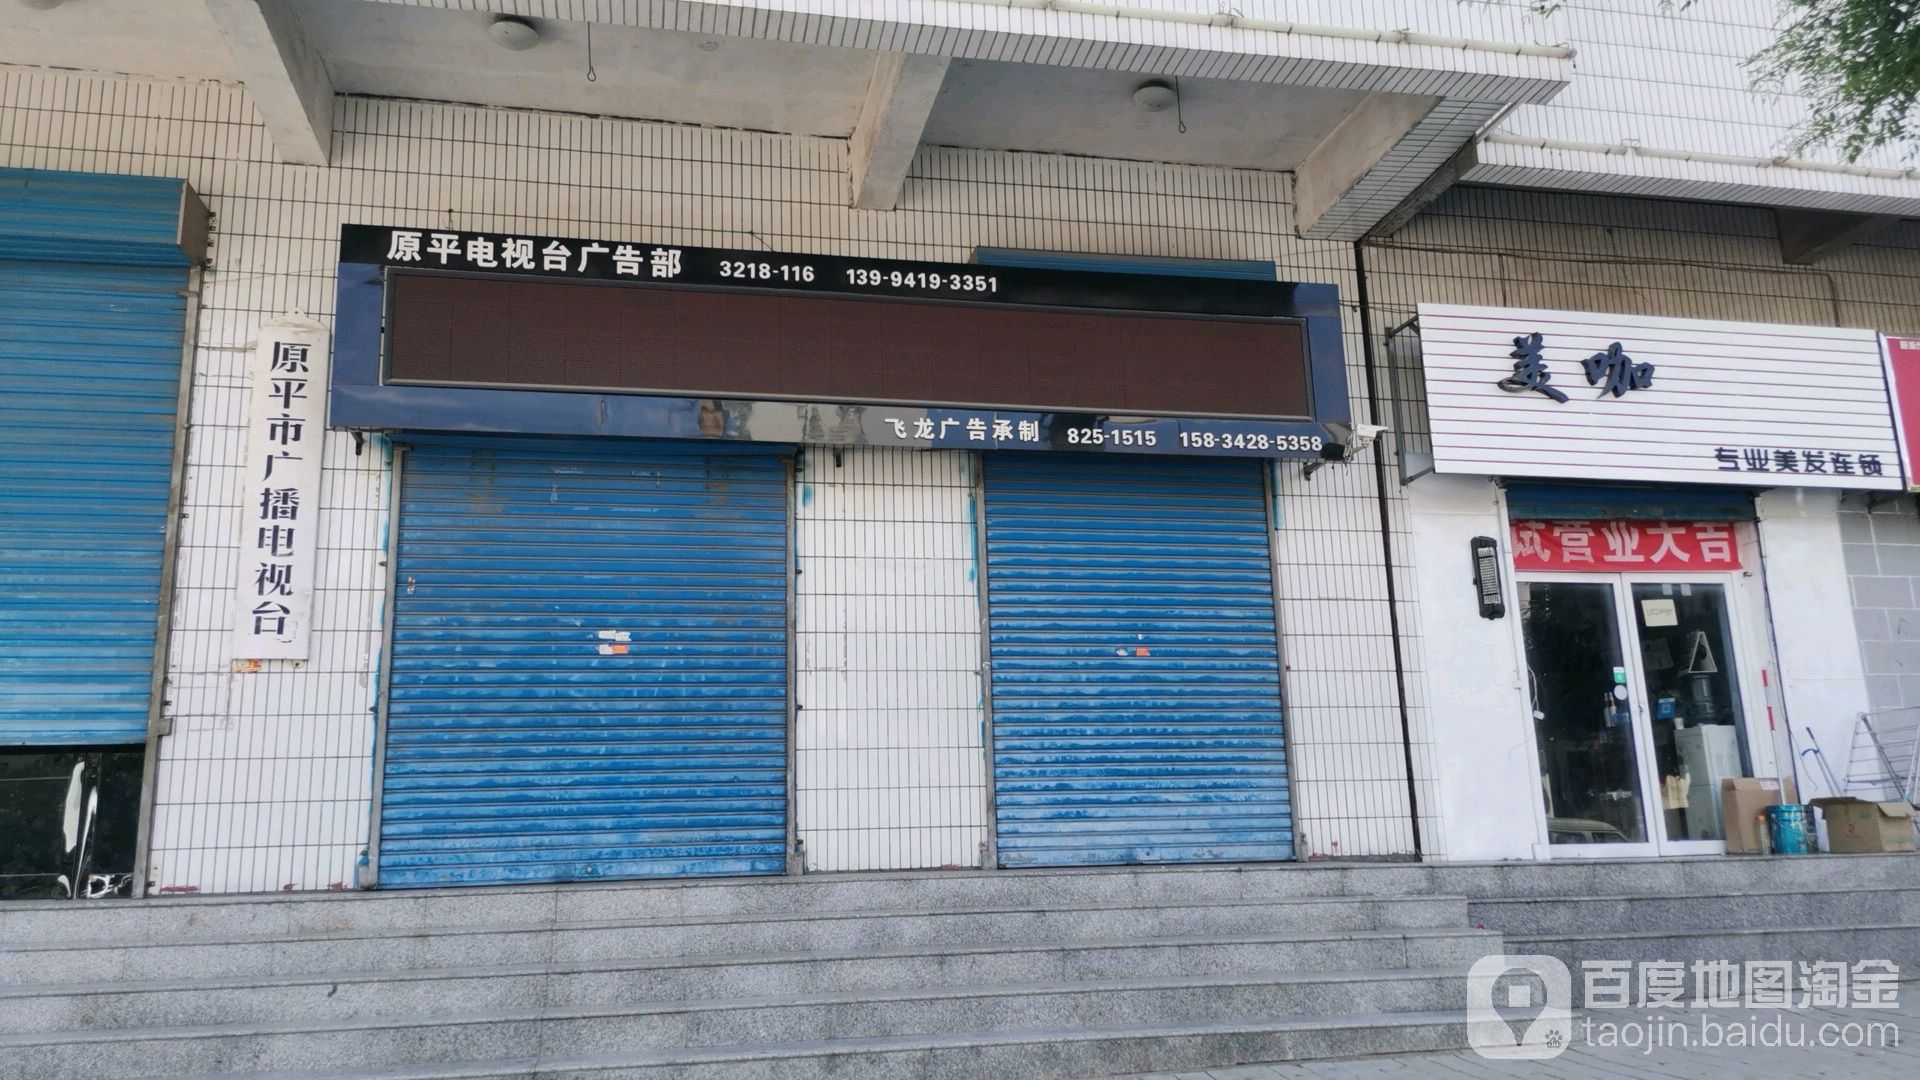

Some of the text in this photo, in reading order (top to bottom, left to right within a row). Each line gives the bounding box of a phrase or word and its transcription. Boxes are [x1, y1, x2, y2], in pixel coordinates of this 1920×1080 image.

[386, 230, 998, 294] 原平电视台广告部 3218-116 139-9419-3351
[1497, 331, 1656, 404] 美咖
[884, 417, 1323, 452] 飞龙广告承制 825-1515 158-3428-5358
[1714, 447, 1883, 476] 专业美发连锁
[252, 341, 312, 637] 原平市广播电视台
